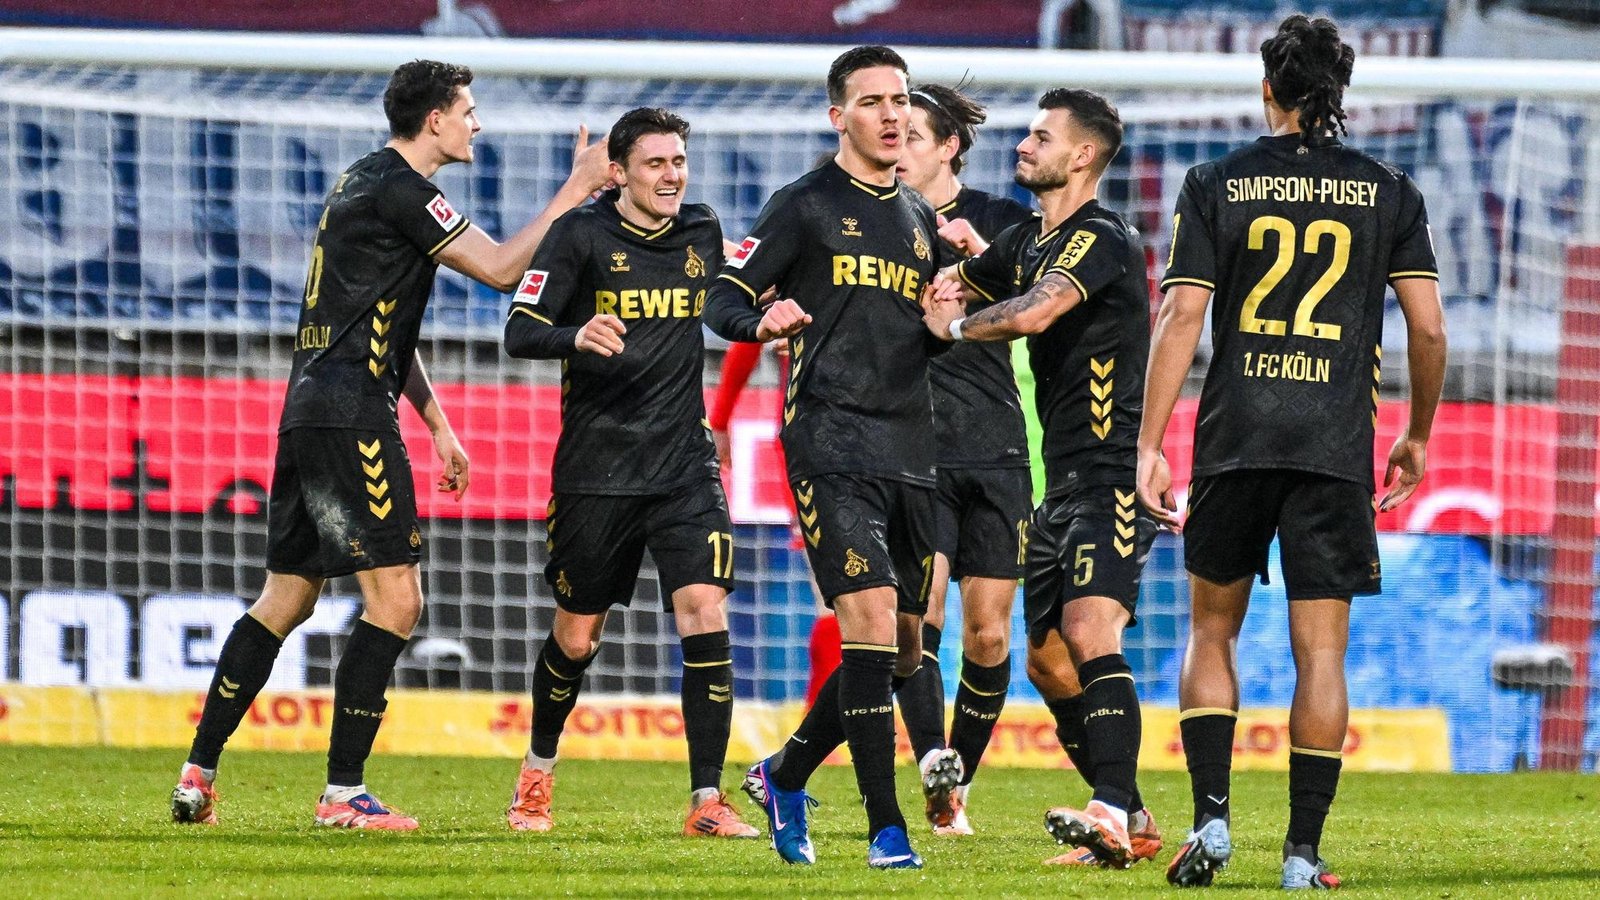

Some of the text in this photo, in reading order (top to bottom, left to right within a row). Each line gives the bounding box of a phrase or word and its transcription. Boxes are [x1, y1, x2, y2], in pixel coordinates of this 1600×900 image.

[1226, 175, 1378, 207] SIMPSON-PUSEY
[1060, 233, 1091, 266] DEVK
[832, 254, 920, 301] REWE
[1238, 215, 1352, 341] 22
[595, 288, 690, 319] REWE
[1243, 350, 1330, 383] 1. FC KÖLN
[707, 531, 733, 579] 17
[1073, 543, 1096, 587] 5
[565, 704, 685, 740] OTTO
